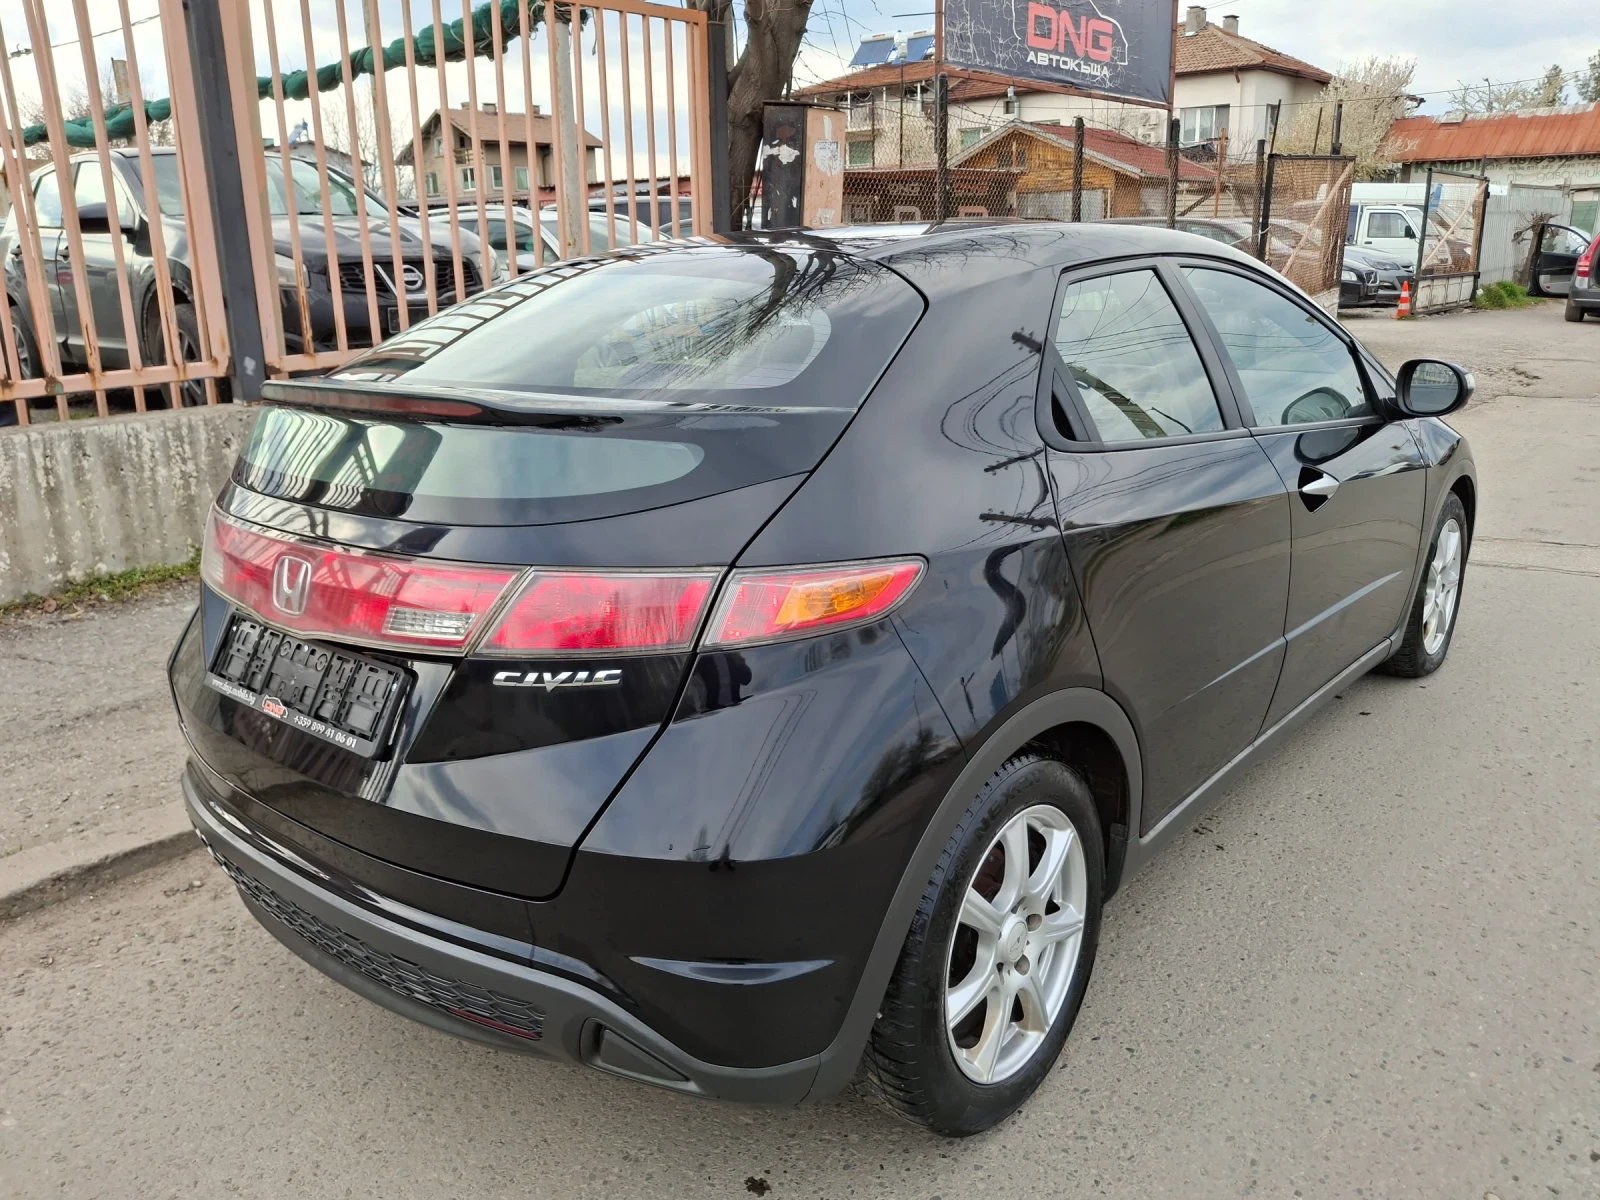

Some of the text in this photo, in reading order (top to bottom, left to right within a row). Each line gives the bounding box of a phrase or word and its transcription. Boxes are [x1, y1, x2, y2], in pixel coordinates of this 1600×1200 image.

[1027, 1, 1114, 63] DNG
[492, 669, 623, 693] CIVIC
[263, 700, 285, 716] DNG
[293, 715, 357, 749] +359 899 41 06 01
